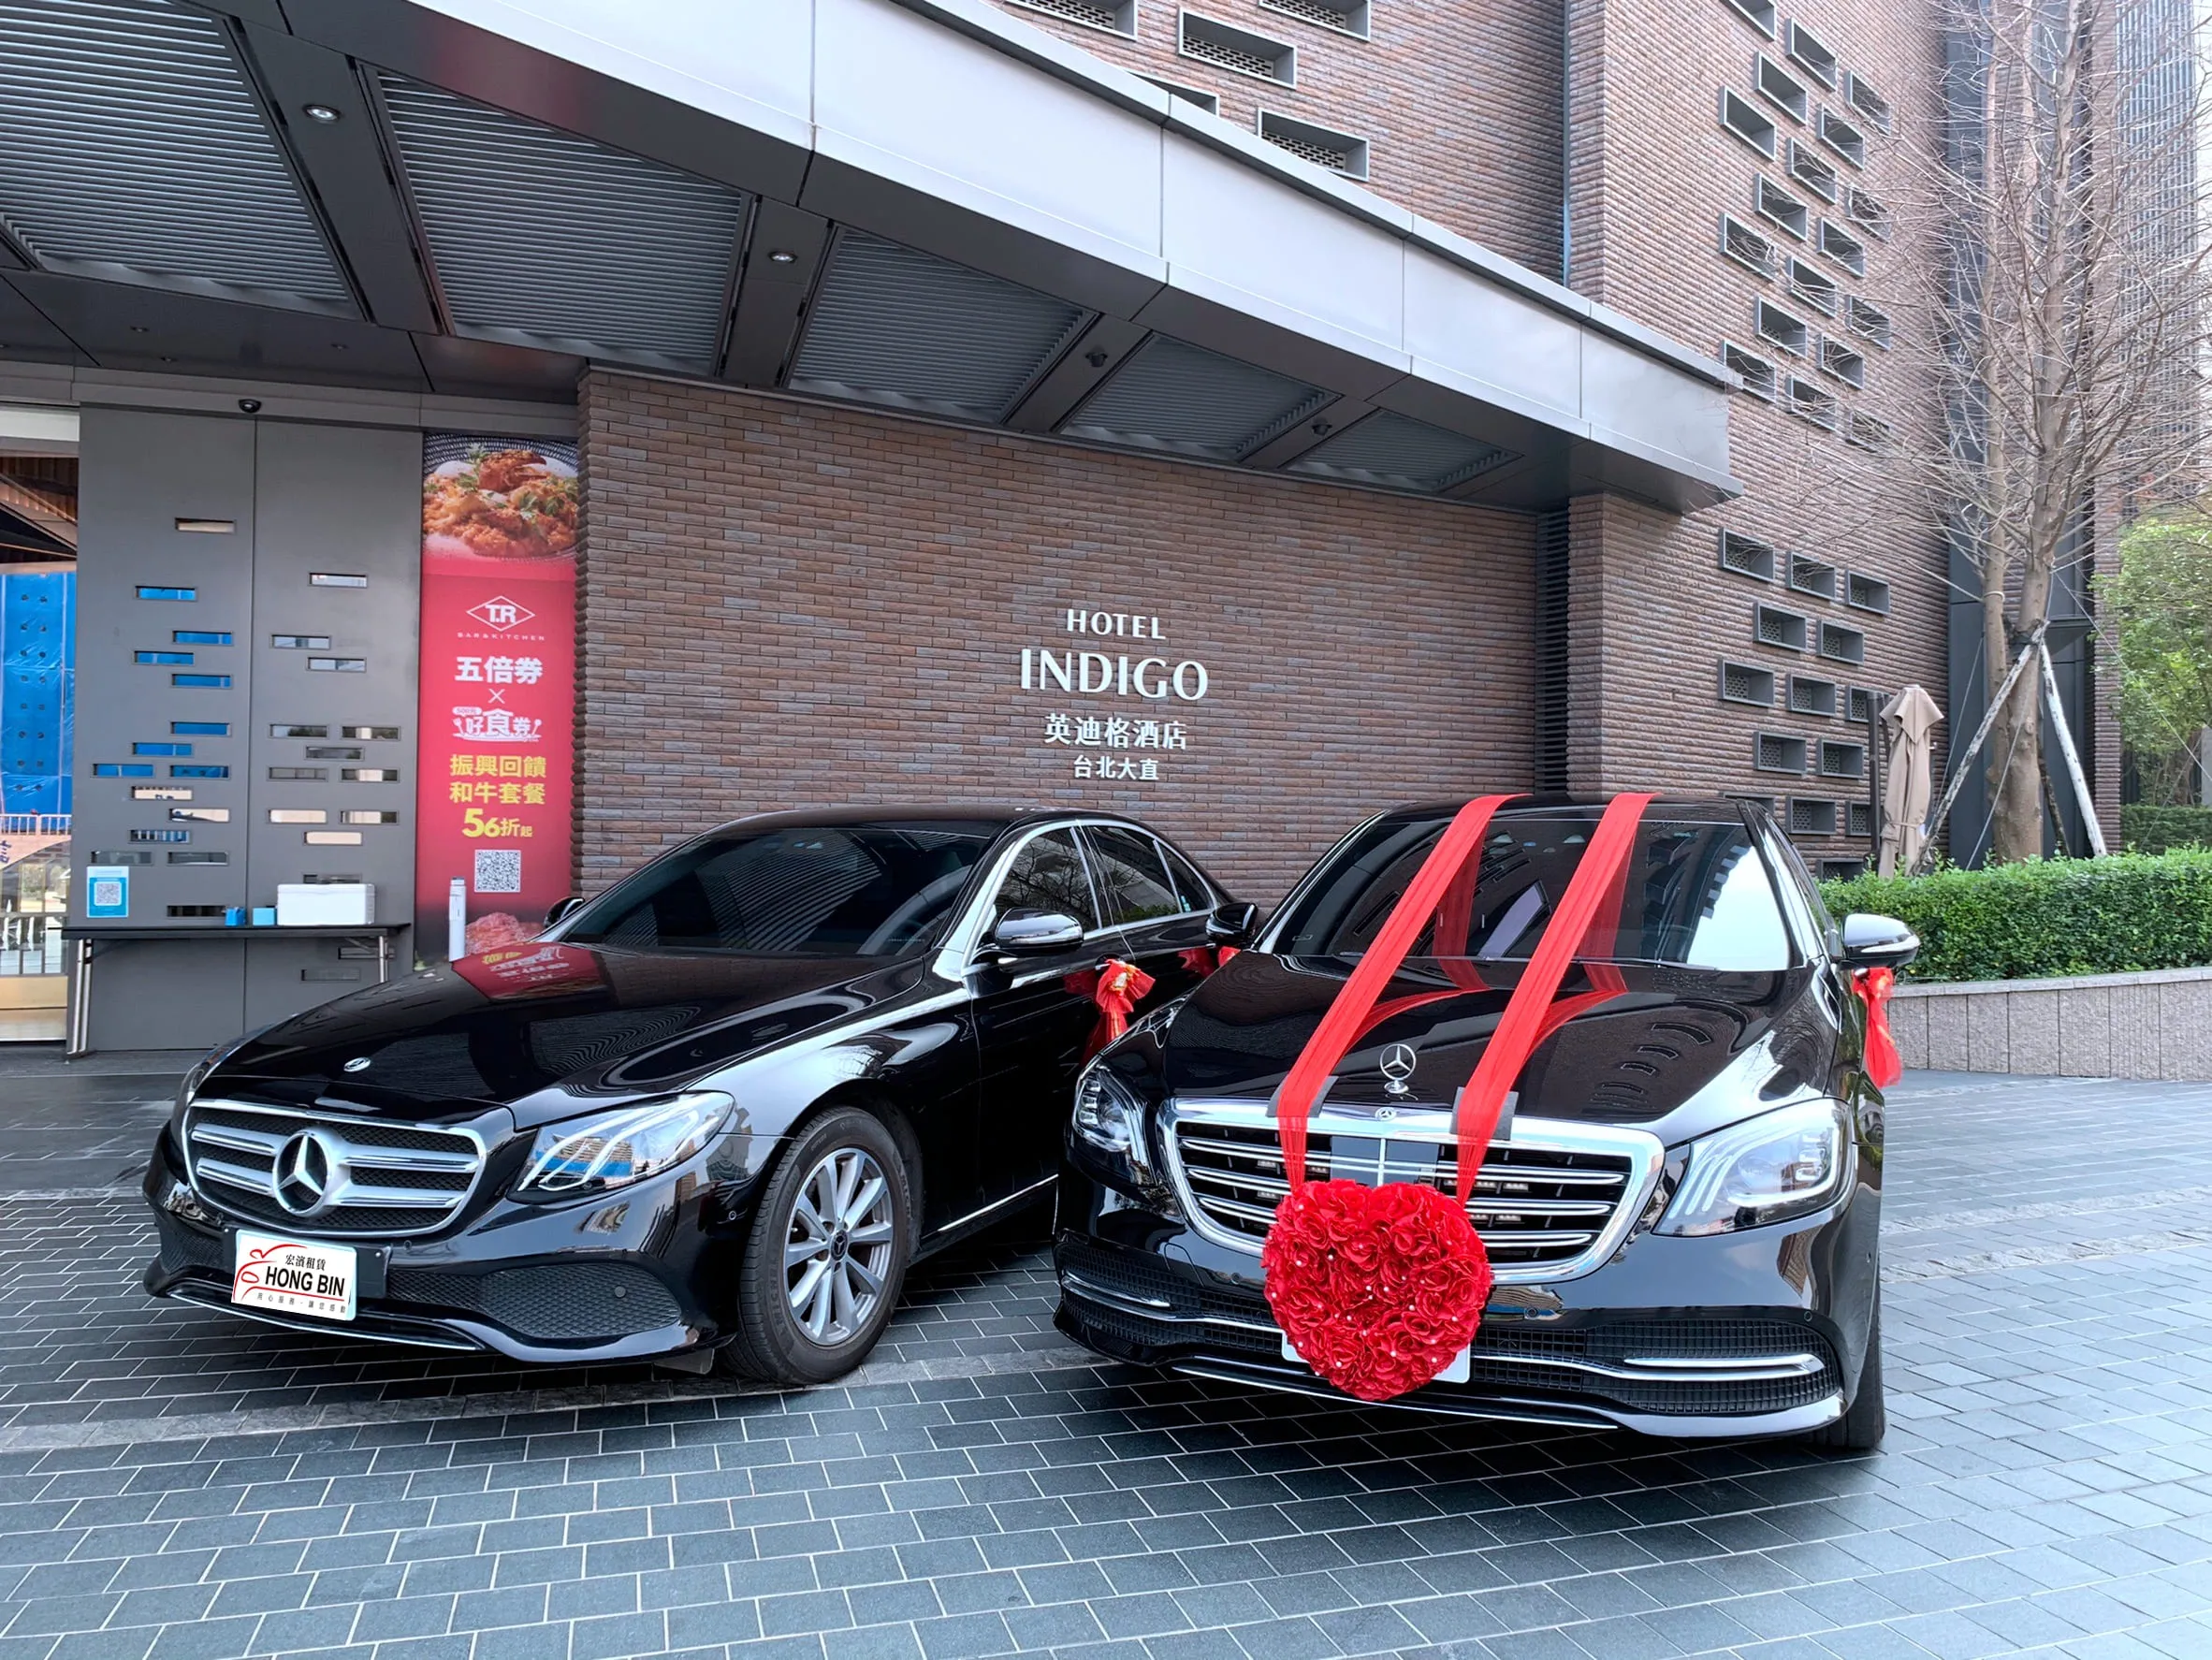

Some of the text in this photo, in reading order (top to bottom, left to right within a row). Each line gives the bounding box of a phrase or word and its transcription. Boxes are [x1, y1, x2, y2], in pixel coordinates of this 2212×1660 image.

[1067, 609, 1166, 640] HOTEL
[455, 656, 543, 684] 五倍券
[1021, 648, 1208, 701] INDIGO
[1044, 713, 1186, 750] 英迪格酒店
[449, 754, 546, 778] 振興回饋
[1073, 754, 1159, 780] 台北大直
[449, 781, 546, 805] 和牛套餐
[462, 808, 532, 837] 56折起
[265, 1266, 345, 1297] HONG BIN
